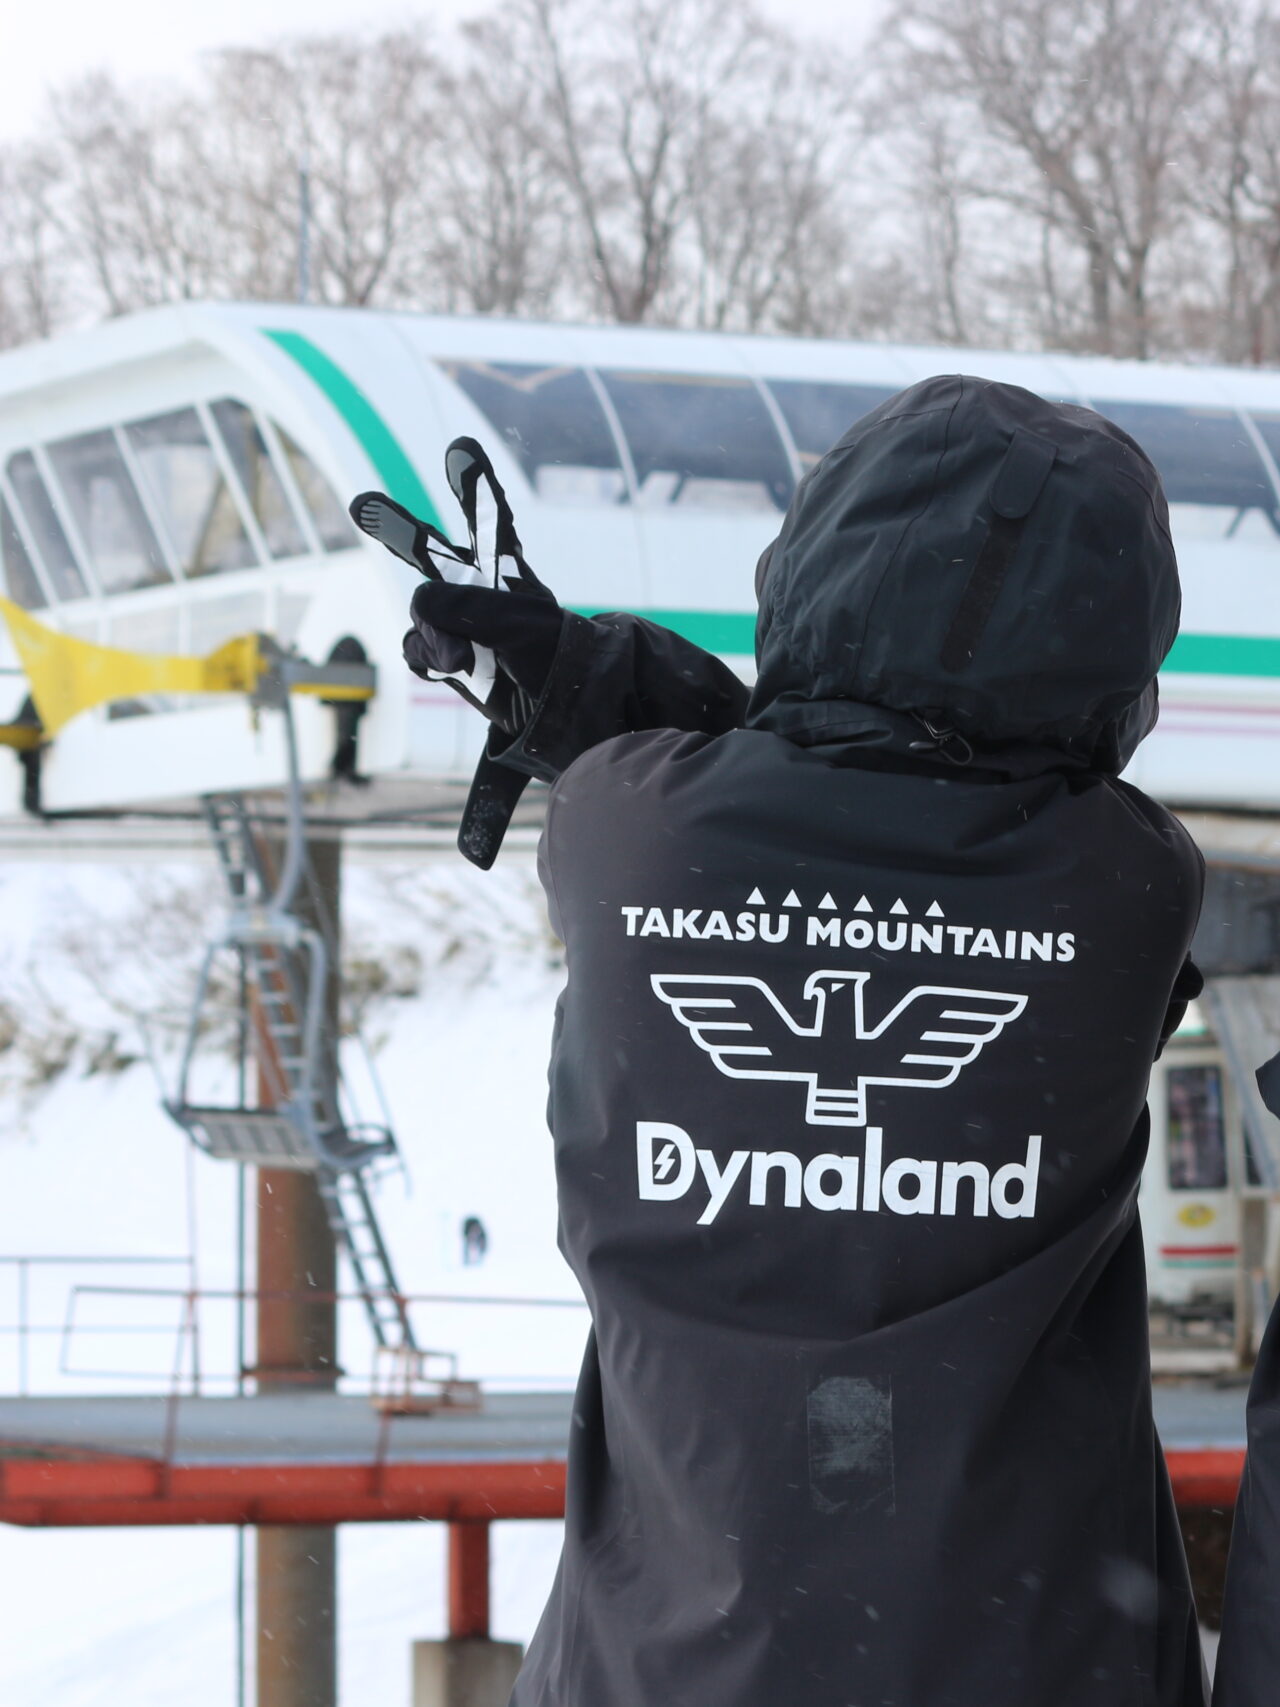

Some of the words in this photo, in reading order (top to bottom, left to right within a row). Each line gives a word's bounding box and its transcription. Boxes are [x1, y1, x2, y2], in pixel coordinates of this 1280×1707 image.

[620, 906, 790, 944] TAKASU
[806, 916, 1076, 963] MOUNTAINS
[636, 1120, 1043, 1226] Dynaland
